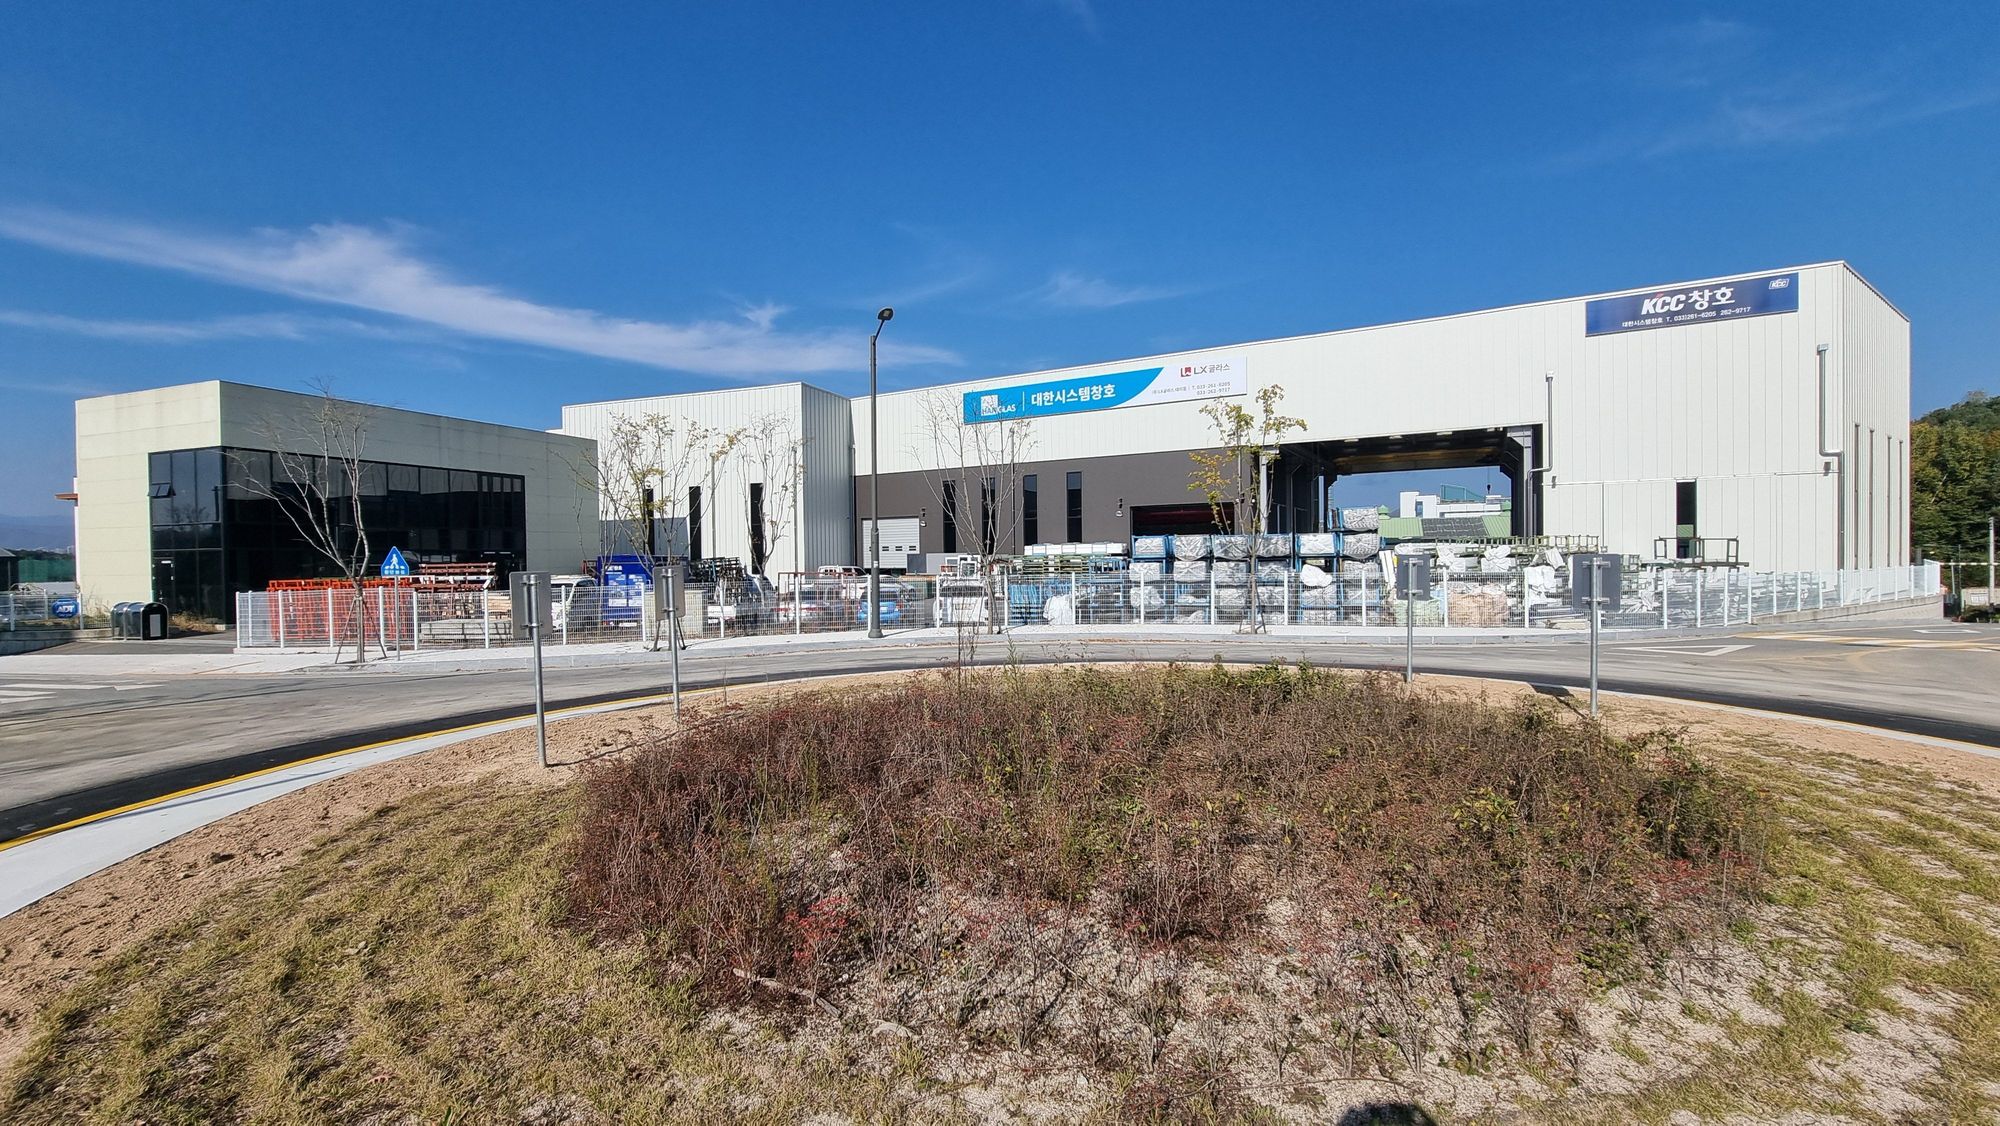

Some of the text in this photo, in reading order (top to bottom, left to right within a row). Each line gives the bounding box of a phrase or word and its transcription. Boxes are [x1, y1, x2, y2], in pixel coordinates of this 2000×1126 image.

[1641, 286, 1736, 315] KCC 창호
[1621, 317, 1663, 327] 대한시스템창호
[1193, 363, 1231, 375] LX 글라스
[1031, 383, 1116, 406] 대한시스템창호
[56, 605, 75, 613] ADT
